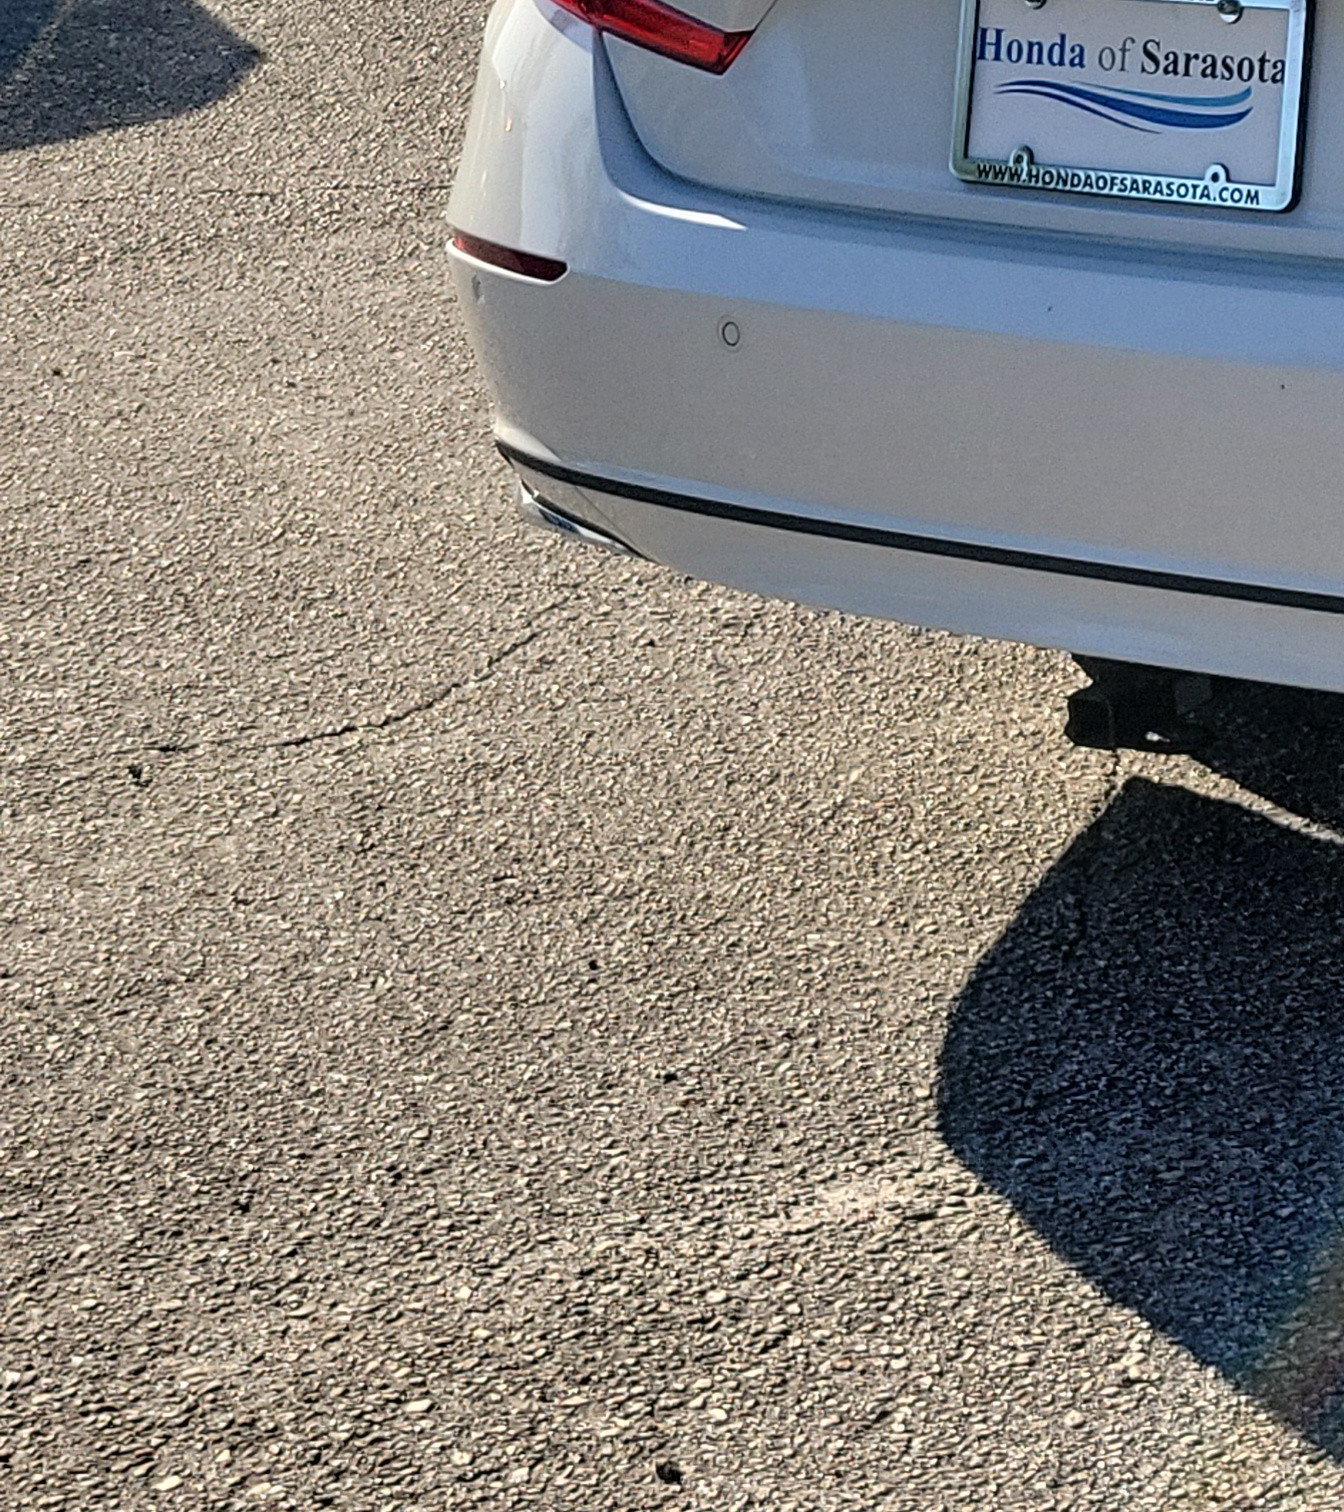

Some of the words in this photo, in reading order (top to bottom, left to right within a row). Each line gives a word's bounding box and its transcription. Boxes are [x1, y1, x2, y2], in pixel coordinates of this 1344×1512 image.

[977, 26, 1086, 68] Honda
[1098, 36, 1136, 72] of
[1140, 38, 1287, 86] Sarasota
[976, 162, 1261, 206] WWW.HONDAOFSARASOTA.COM
